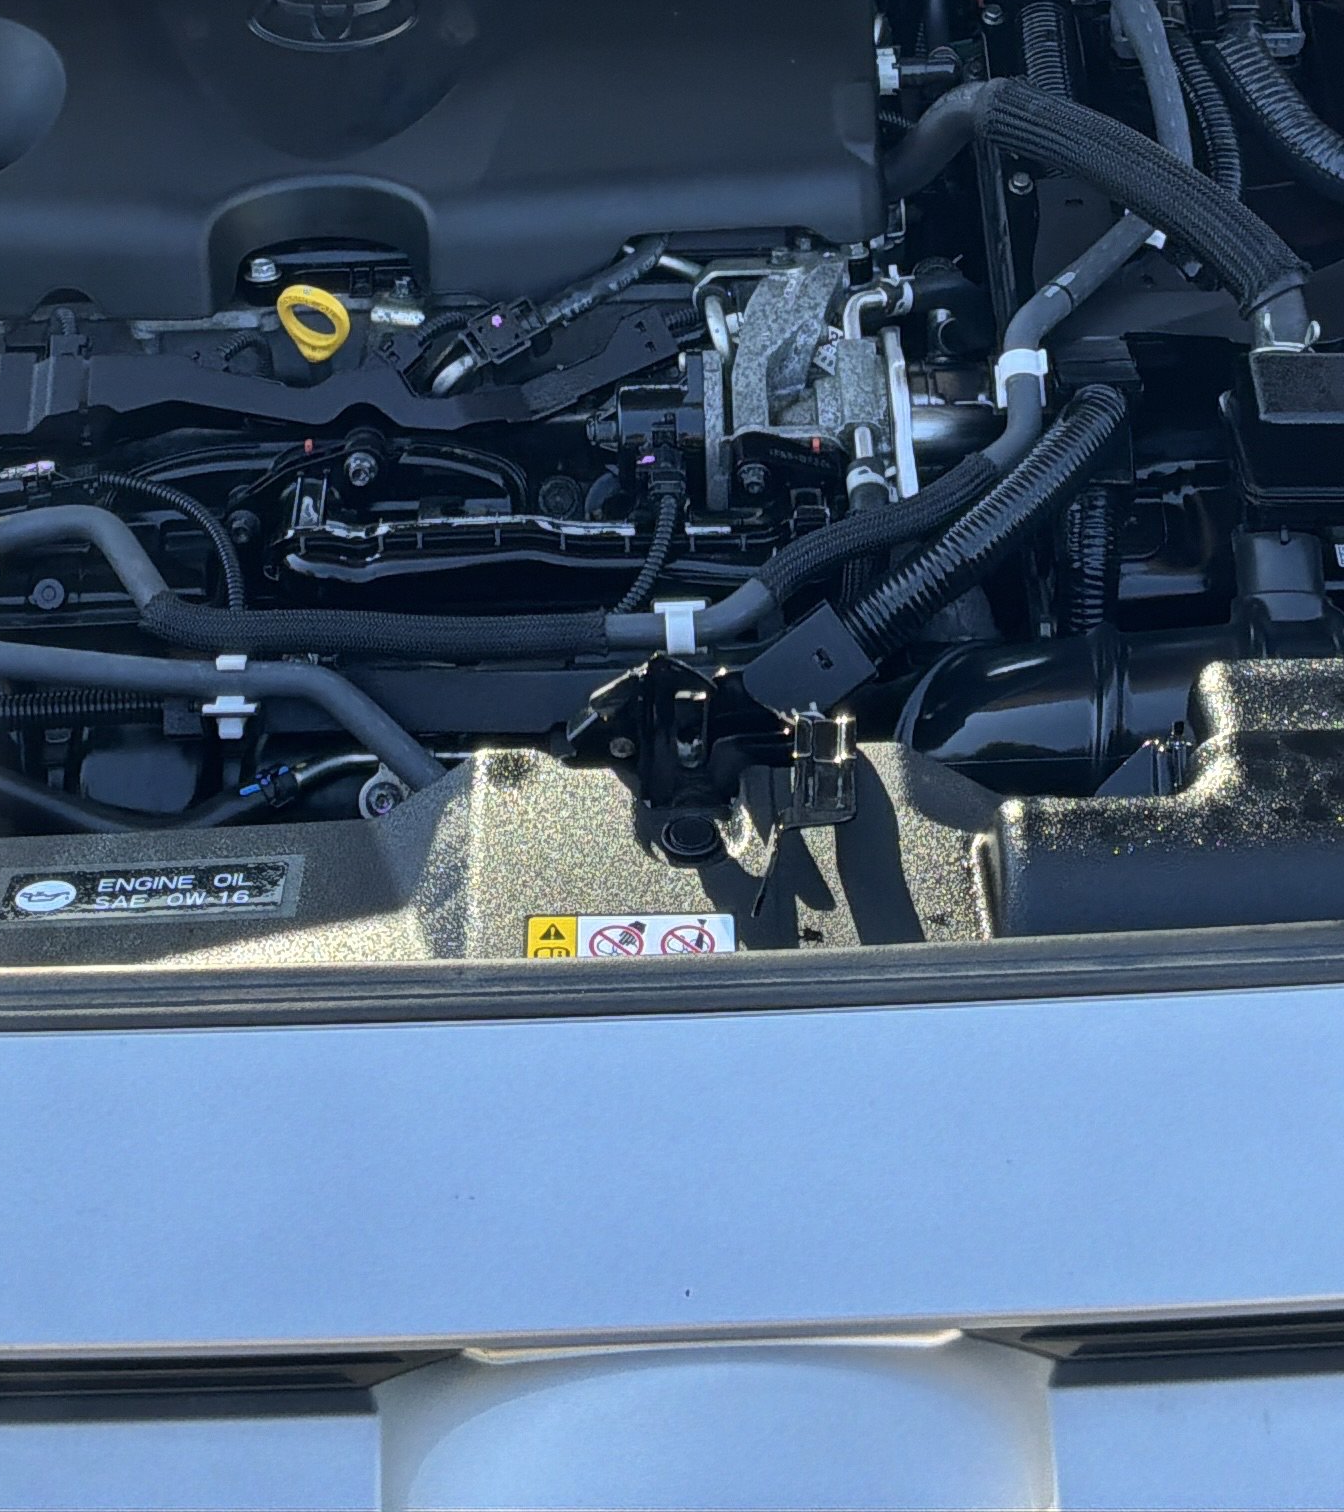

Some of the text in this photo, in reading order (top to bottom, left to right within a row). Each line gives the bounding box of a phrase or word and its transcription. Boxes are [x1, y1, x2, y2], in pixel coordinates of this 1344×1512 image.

[98, 873, 253, 892] ENGINE OIL
[95, 894, 149, 910] SAE
